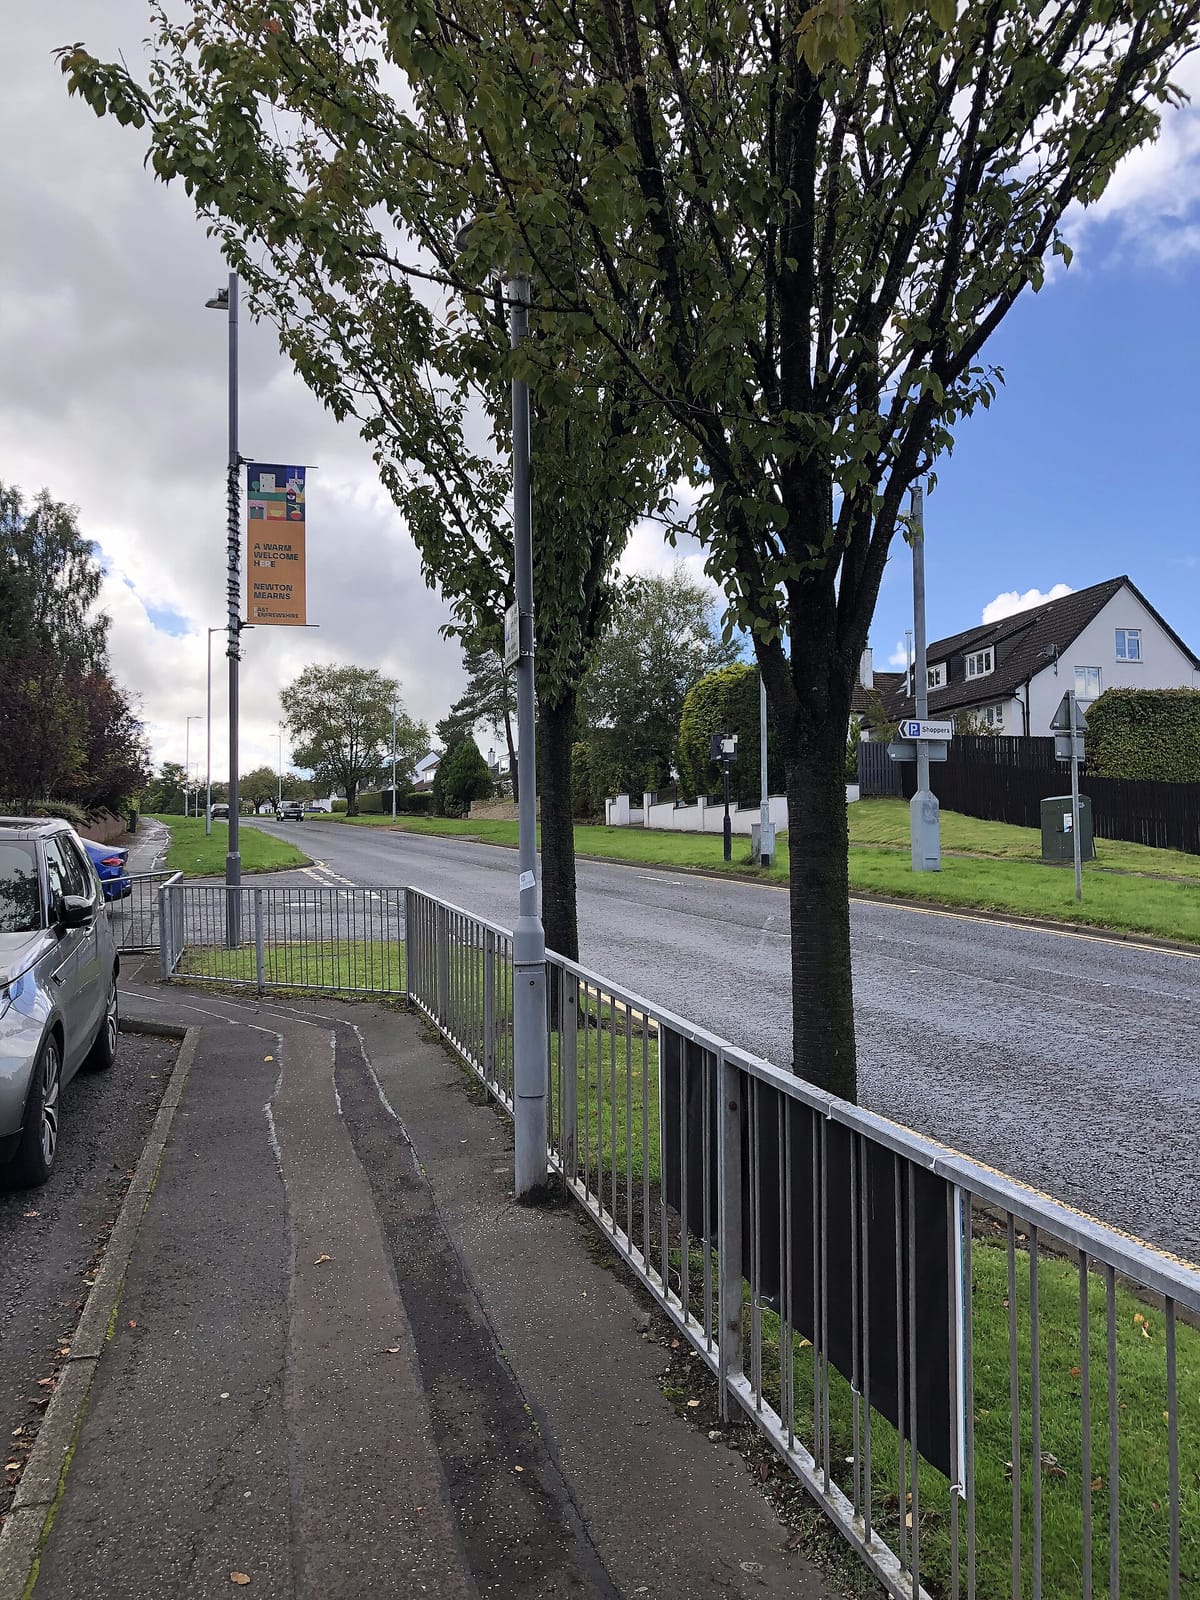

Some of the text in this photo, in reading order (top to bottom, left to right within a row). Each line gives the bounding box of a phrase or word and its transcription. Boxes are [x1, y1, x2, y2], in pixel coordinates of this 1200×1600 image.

[263, 543, 292, 551] WARM
[254, 551, 299, 560] WELCOME
[254, 583, 292, 591] NEWTON
[254, 592, 291, 600] MEARNS
[910, 723, 950, 735] P Shoppers
